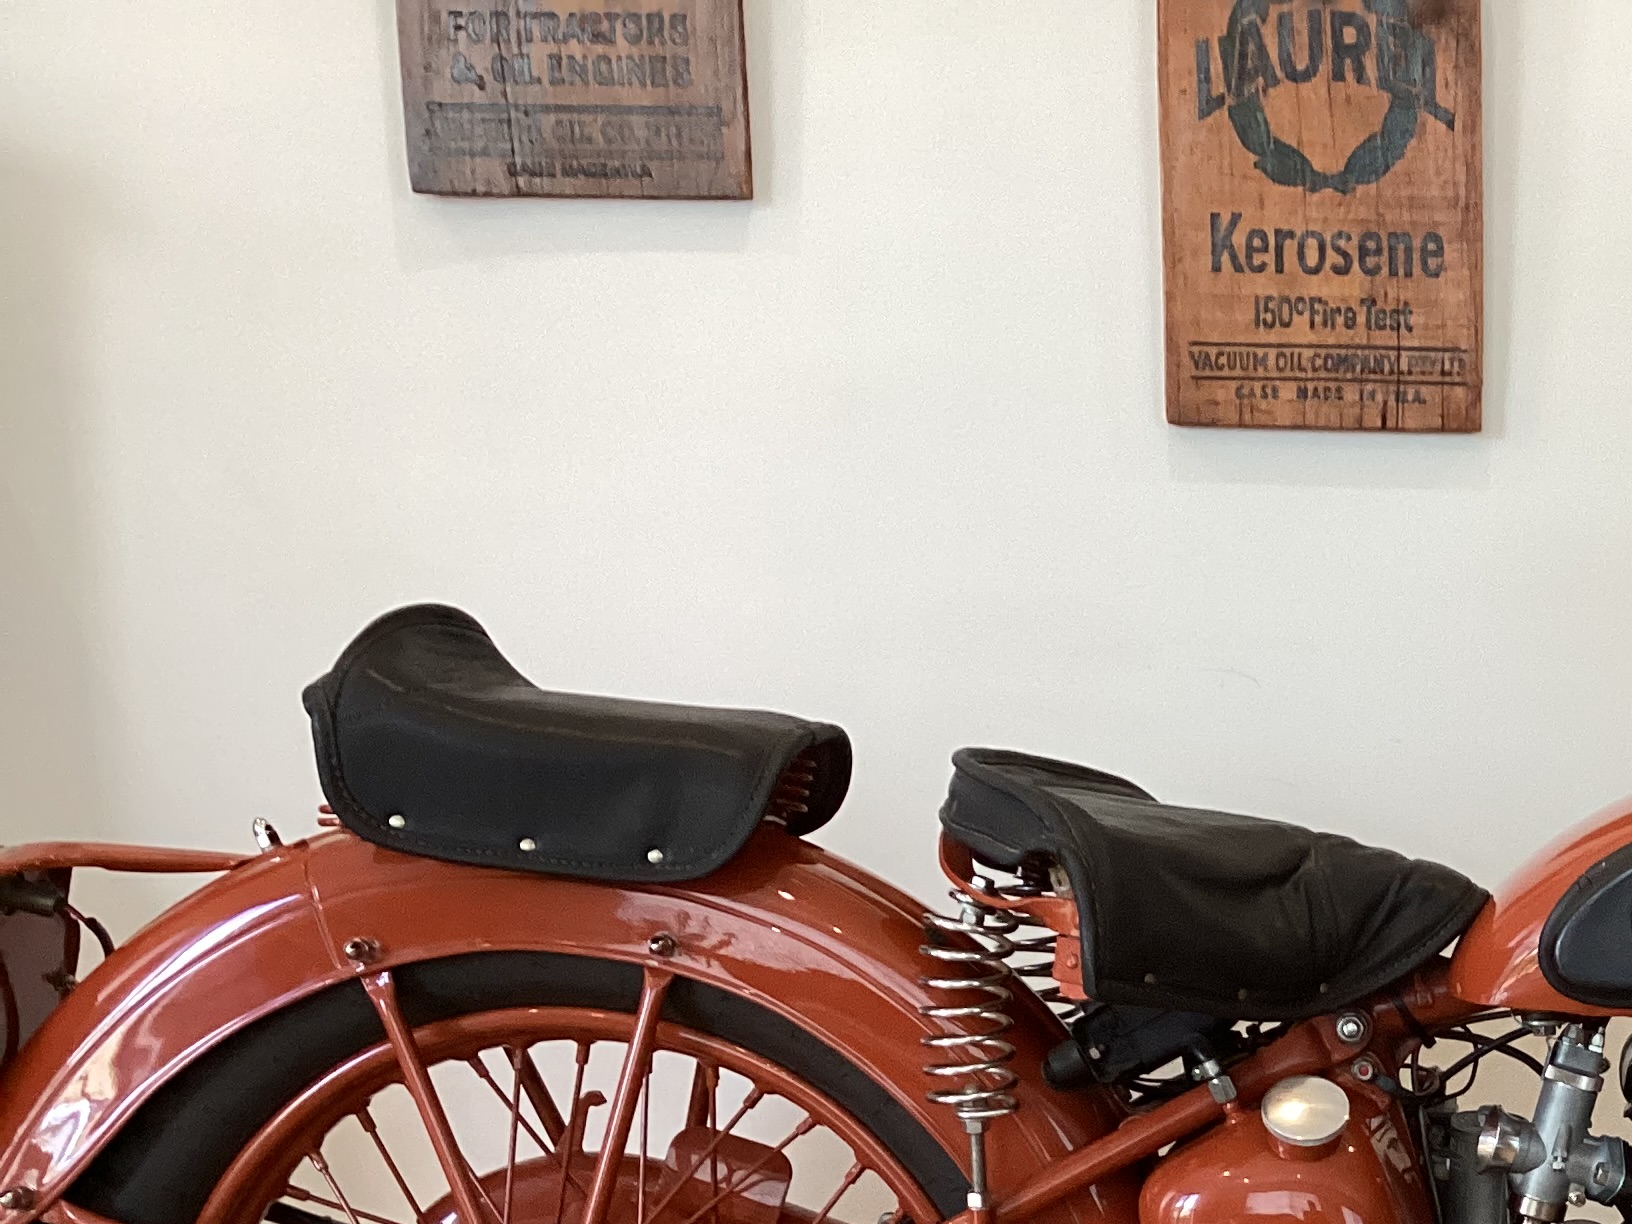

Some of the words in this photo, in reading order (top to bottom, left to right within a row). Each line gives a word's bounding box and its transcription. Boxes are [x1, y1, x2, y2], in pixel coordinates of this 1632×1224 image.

[517, 11, 689, 46] TRACTORS
[546, 53, 692, 88] ENGINES
[1209, 211, 1447, 279] Kerosene
[1190, 350, 1268, 372] VACUUM
